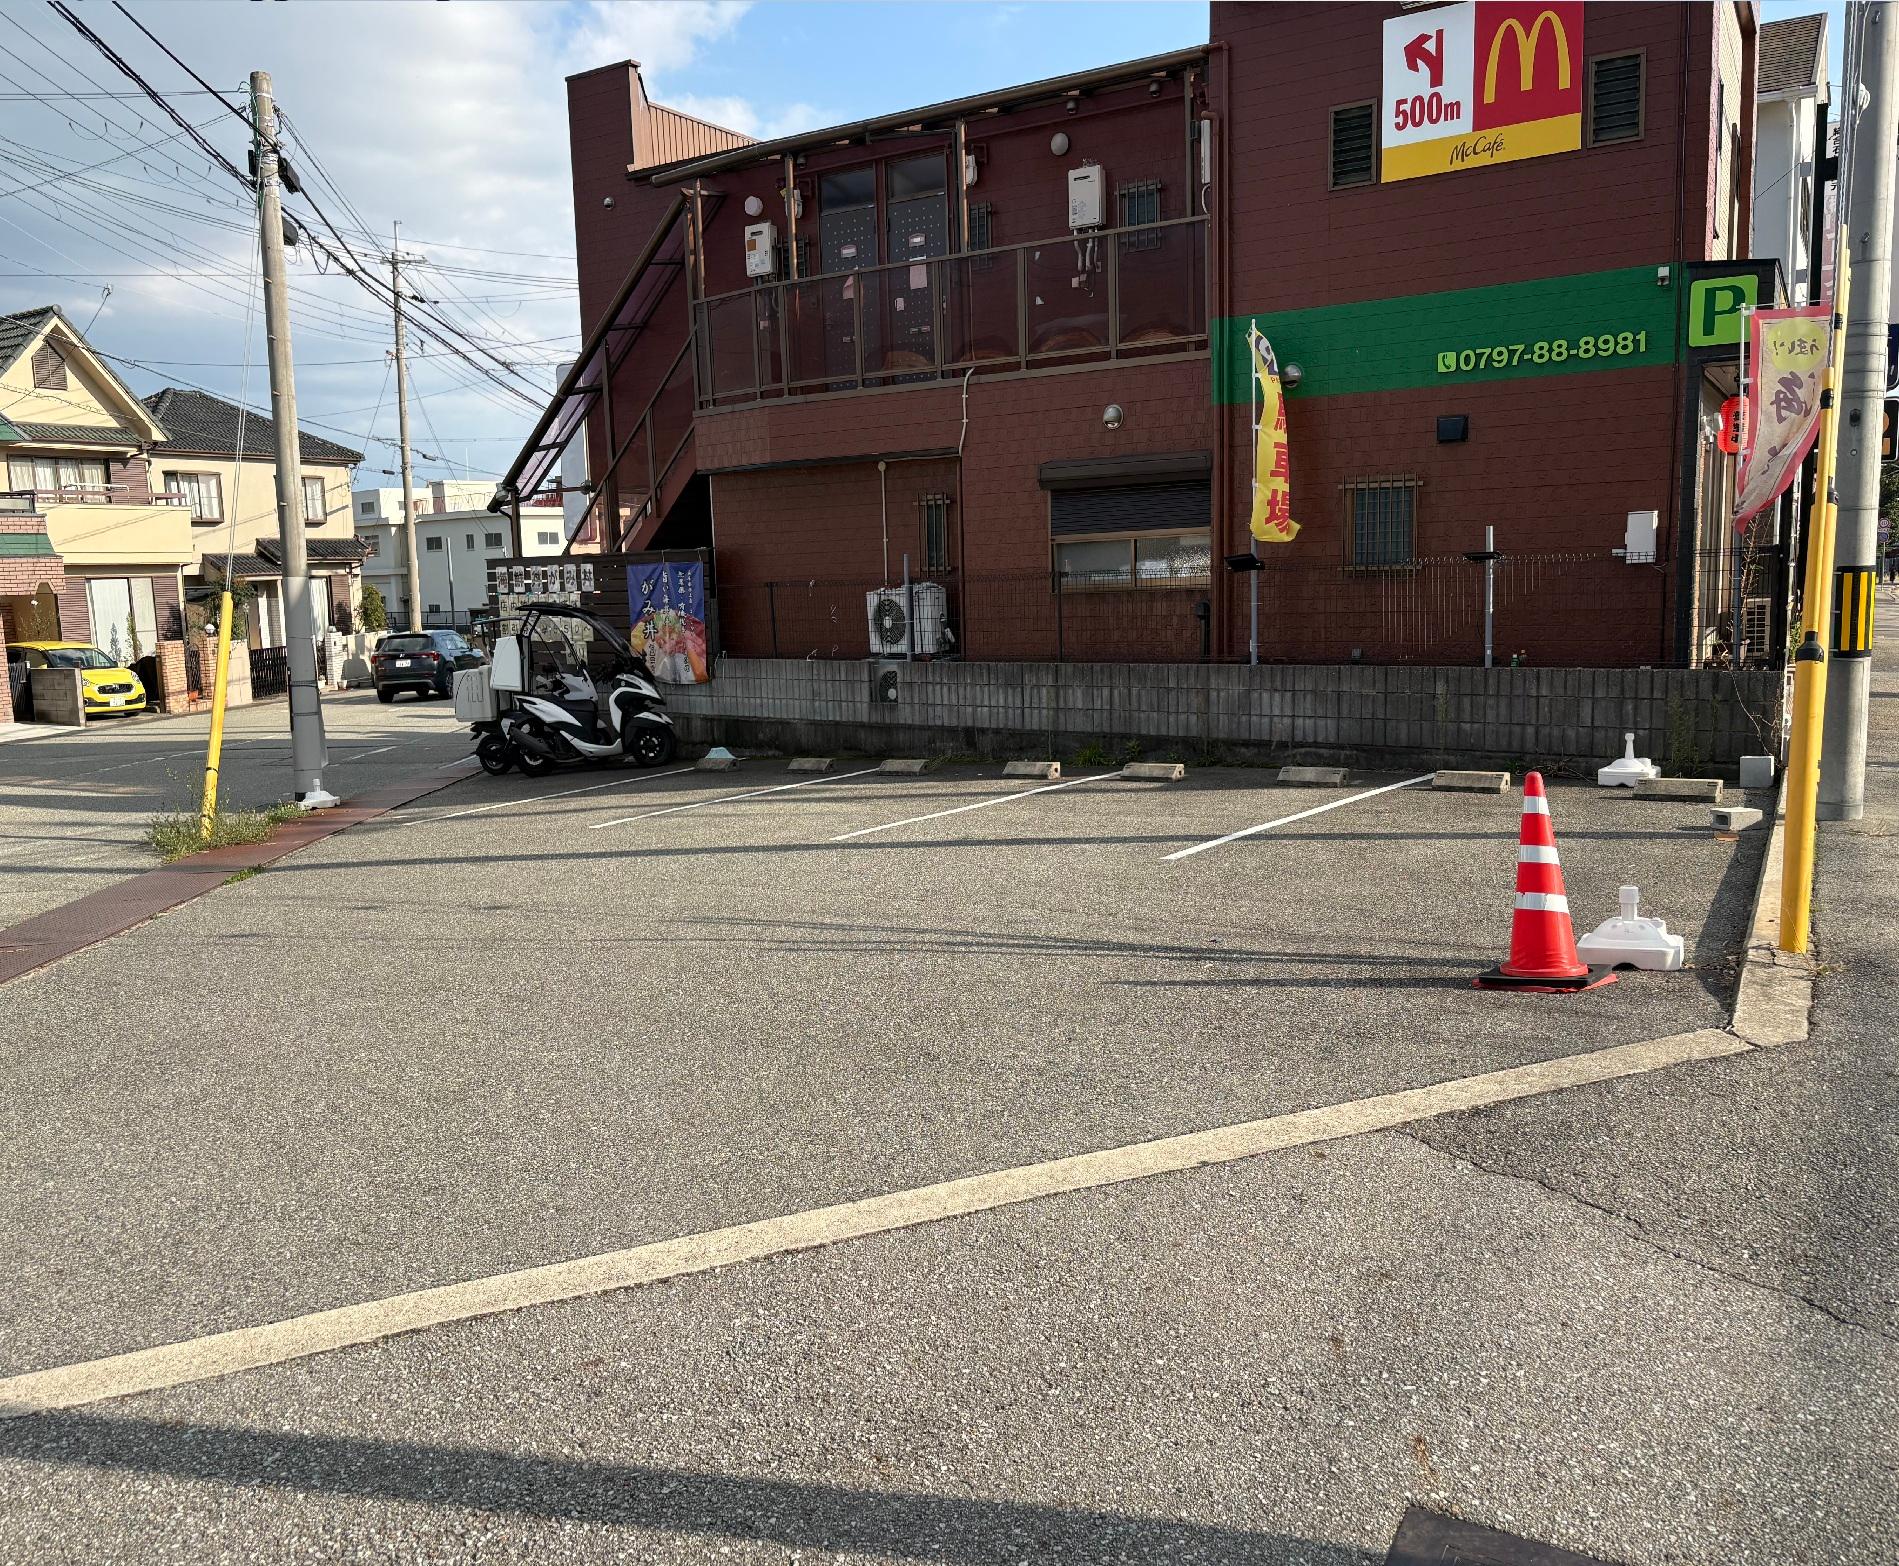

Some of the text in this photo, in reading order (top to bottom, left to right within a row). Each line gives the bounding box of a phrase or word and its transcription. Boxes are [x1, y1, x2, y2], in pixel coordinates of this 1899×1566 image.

[1394, 92, 1461, 131] 500m
[1450, 133, 1505, 165] McCafé
[1702, 284, 1746, 336] P
[1459, 331, 1647, 371] 0797-88-8981
